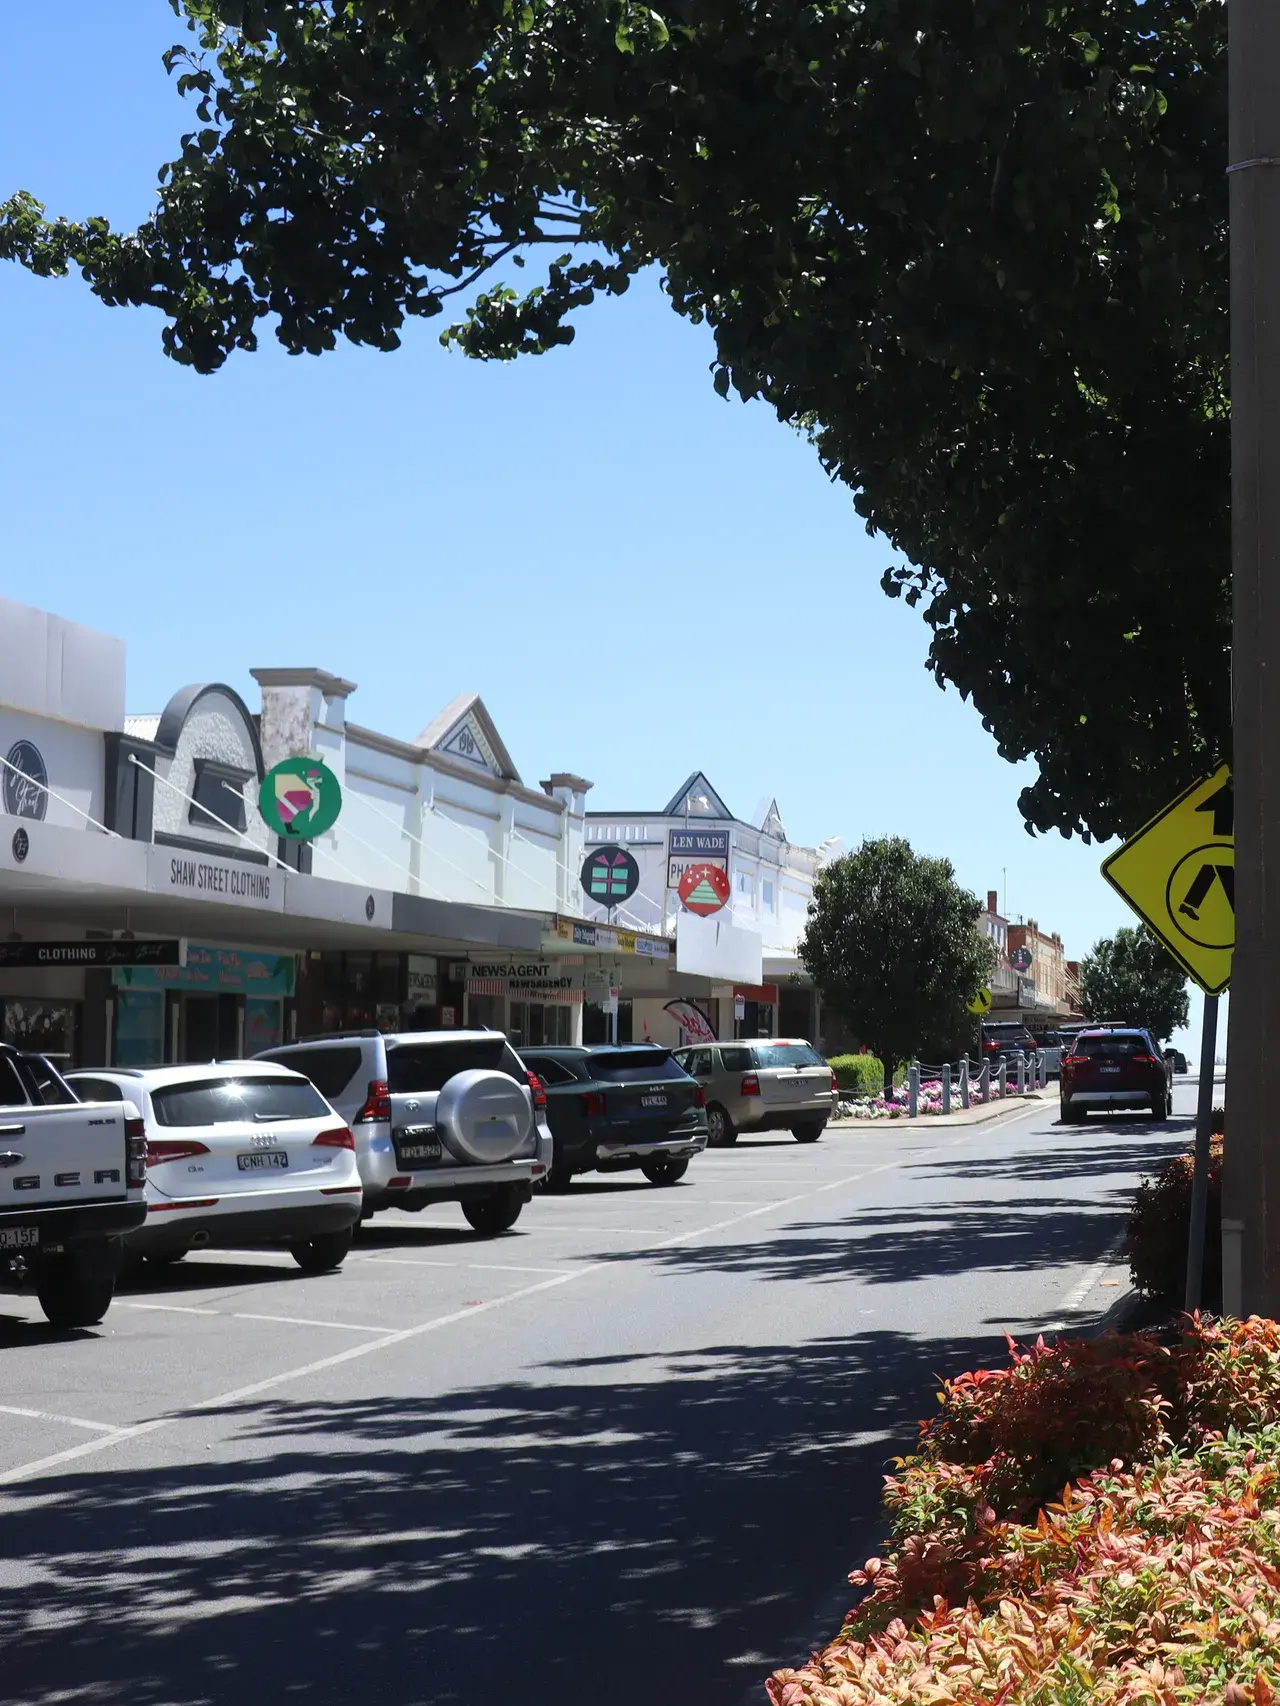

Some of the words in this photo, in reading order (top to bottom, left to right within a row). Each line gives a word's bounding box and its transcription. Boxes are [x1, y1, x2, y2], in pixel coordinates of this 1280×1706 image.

[672, 836, 693, 848] LEN
[696, 836, 725, 849] WADE
[170, 858, 196, 887] SHAW
[198, 864, 229, 892] STREET
[231, 870, 270, 900] CLOTHING
[38, 948, 96, 960] CLOTHING
[472, 965, 549, 977] NEWSAGENT
[509, 977, 573, 989] NEWSAGENCY
[243, 1156, 264, 1168] CNH
